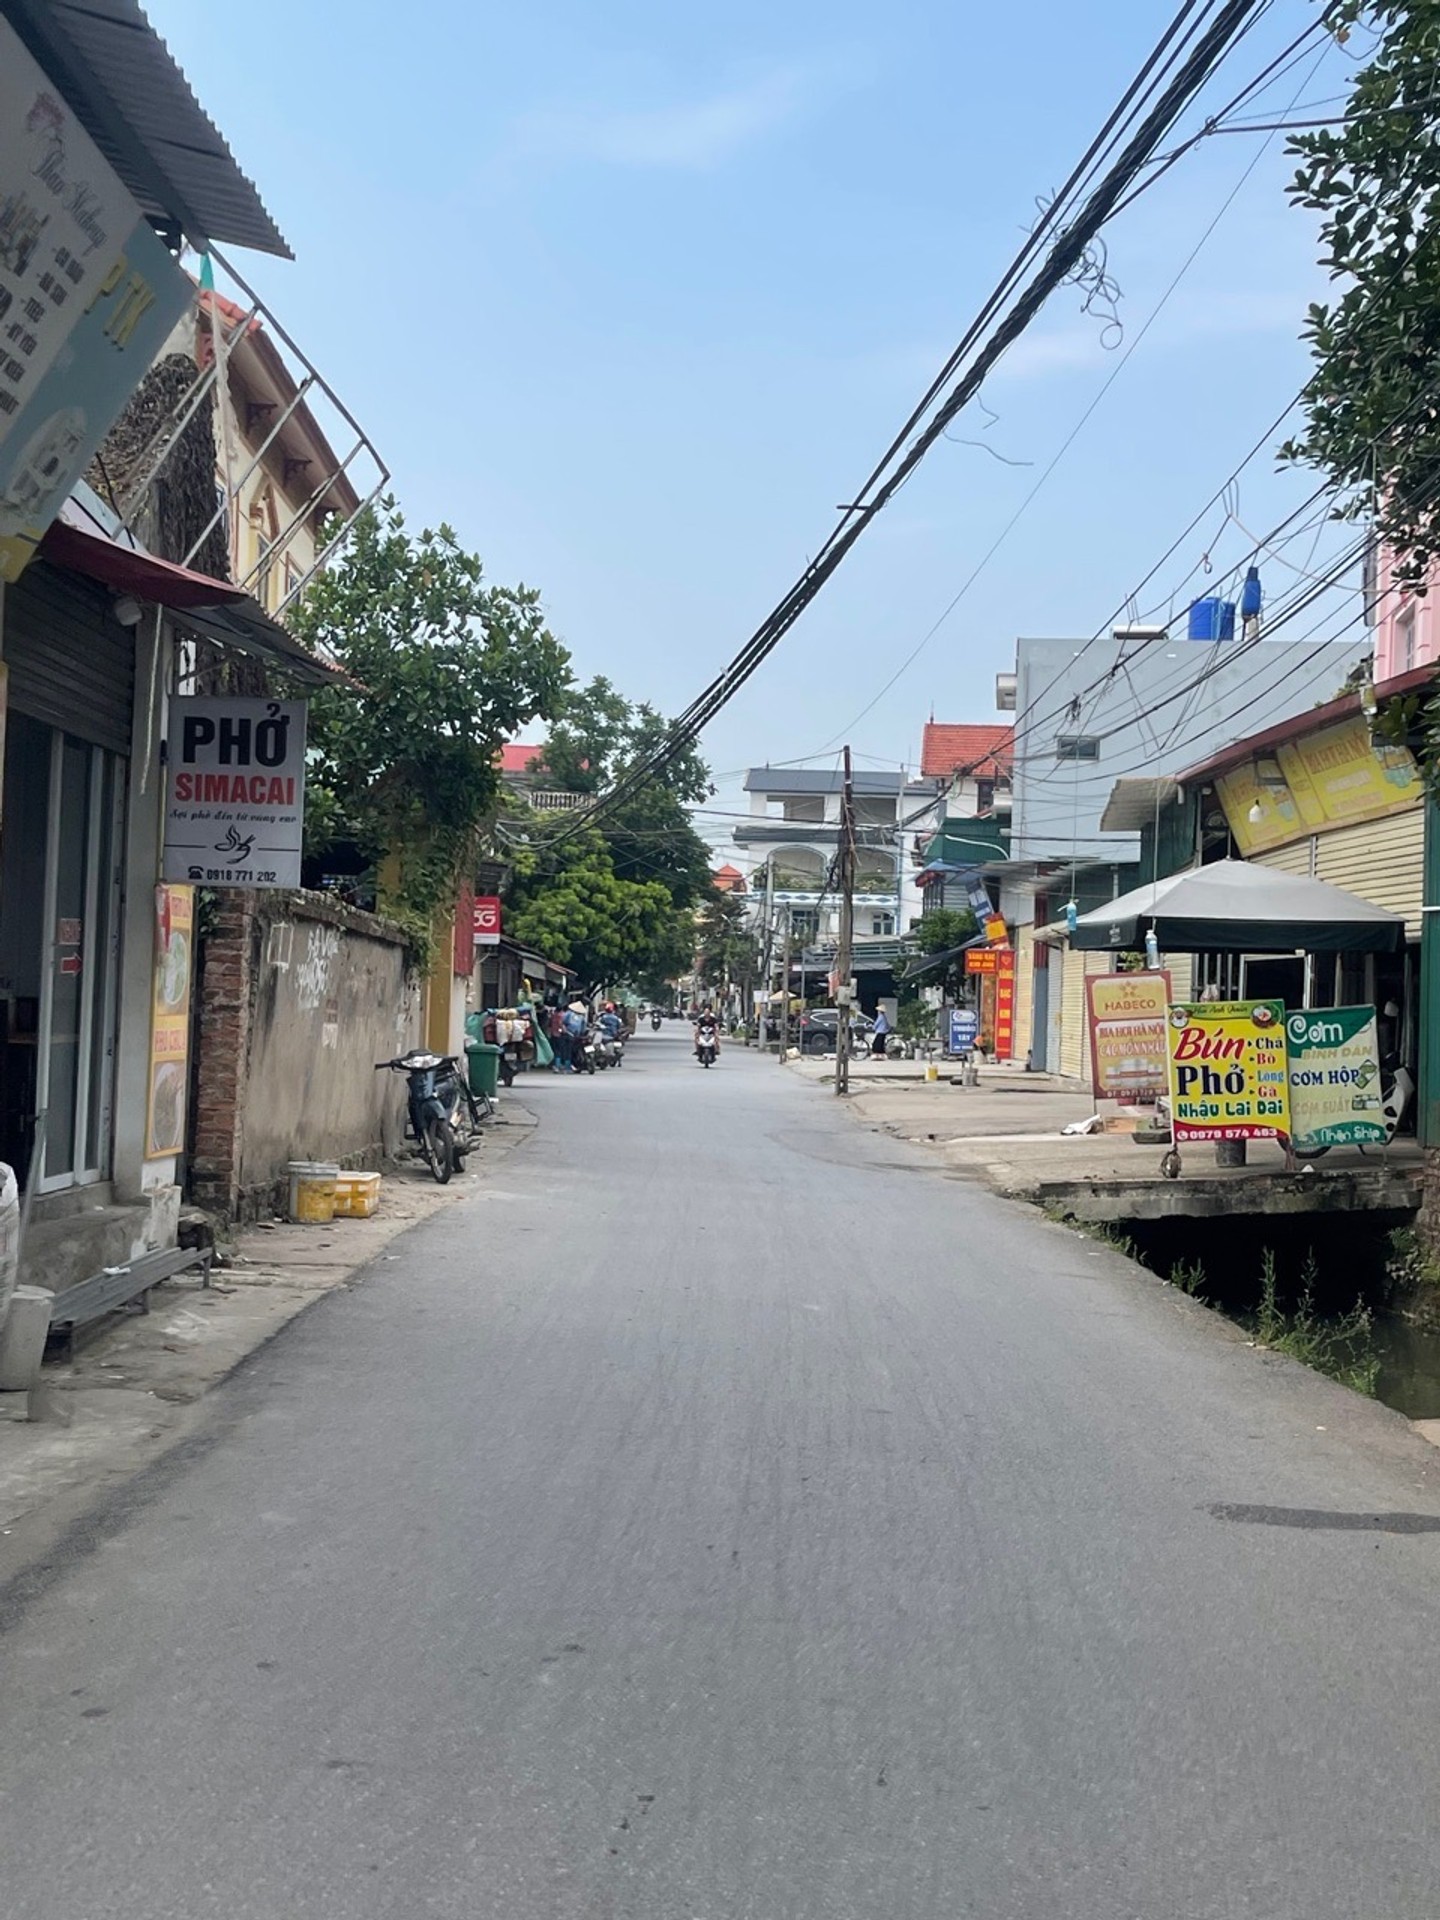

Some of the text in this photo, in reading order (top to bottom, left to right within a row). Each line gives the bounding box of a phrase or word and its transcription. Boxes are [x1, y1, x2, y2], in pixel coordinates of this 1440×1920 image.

[183, 703, 290, 767] PHỞ
[175, 773, 295, 805] SIMACAI
[235, 869, 253, 882] 771
[256, 870, 277, 883] 202
[1105, 999, 1156, 1011] HABECO
[1286, 1014, 1344, 1044] Cơm
[1173, 1027, 1245, 1060] Bún
[1176, 1063, 1245, 1096] Phở
[1290, 1065, 1360, 1087] CƠM HỘP
[1178, 1099, 1219, 1120] Nhậu
[1225, 1100, 1251, 1116] Lai
[1354, 1125, 1380, 1141] Ship
